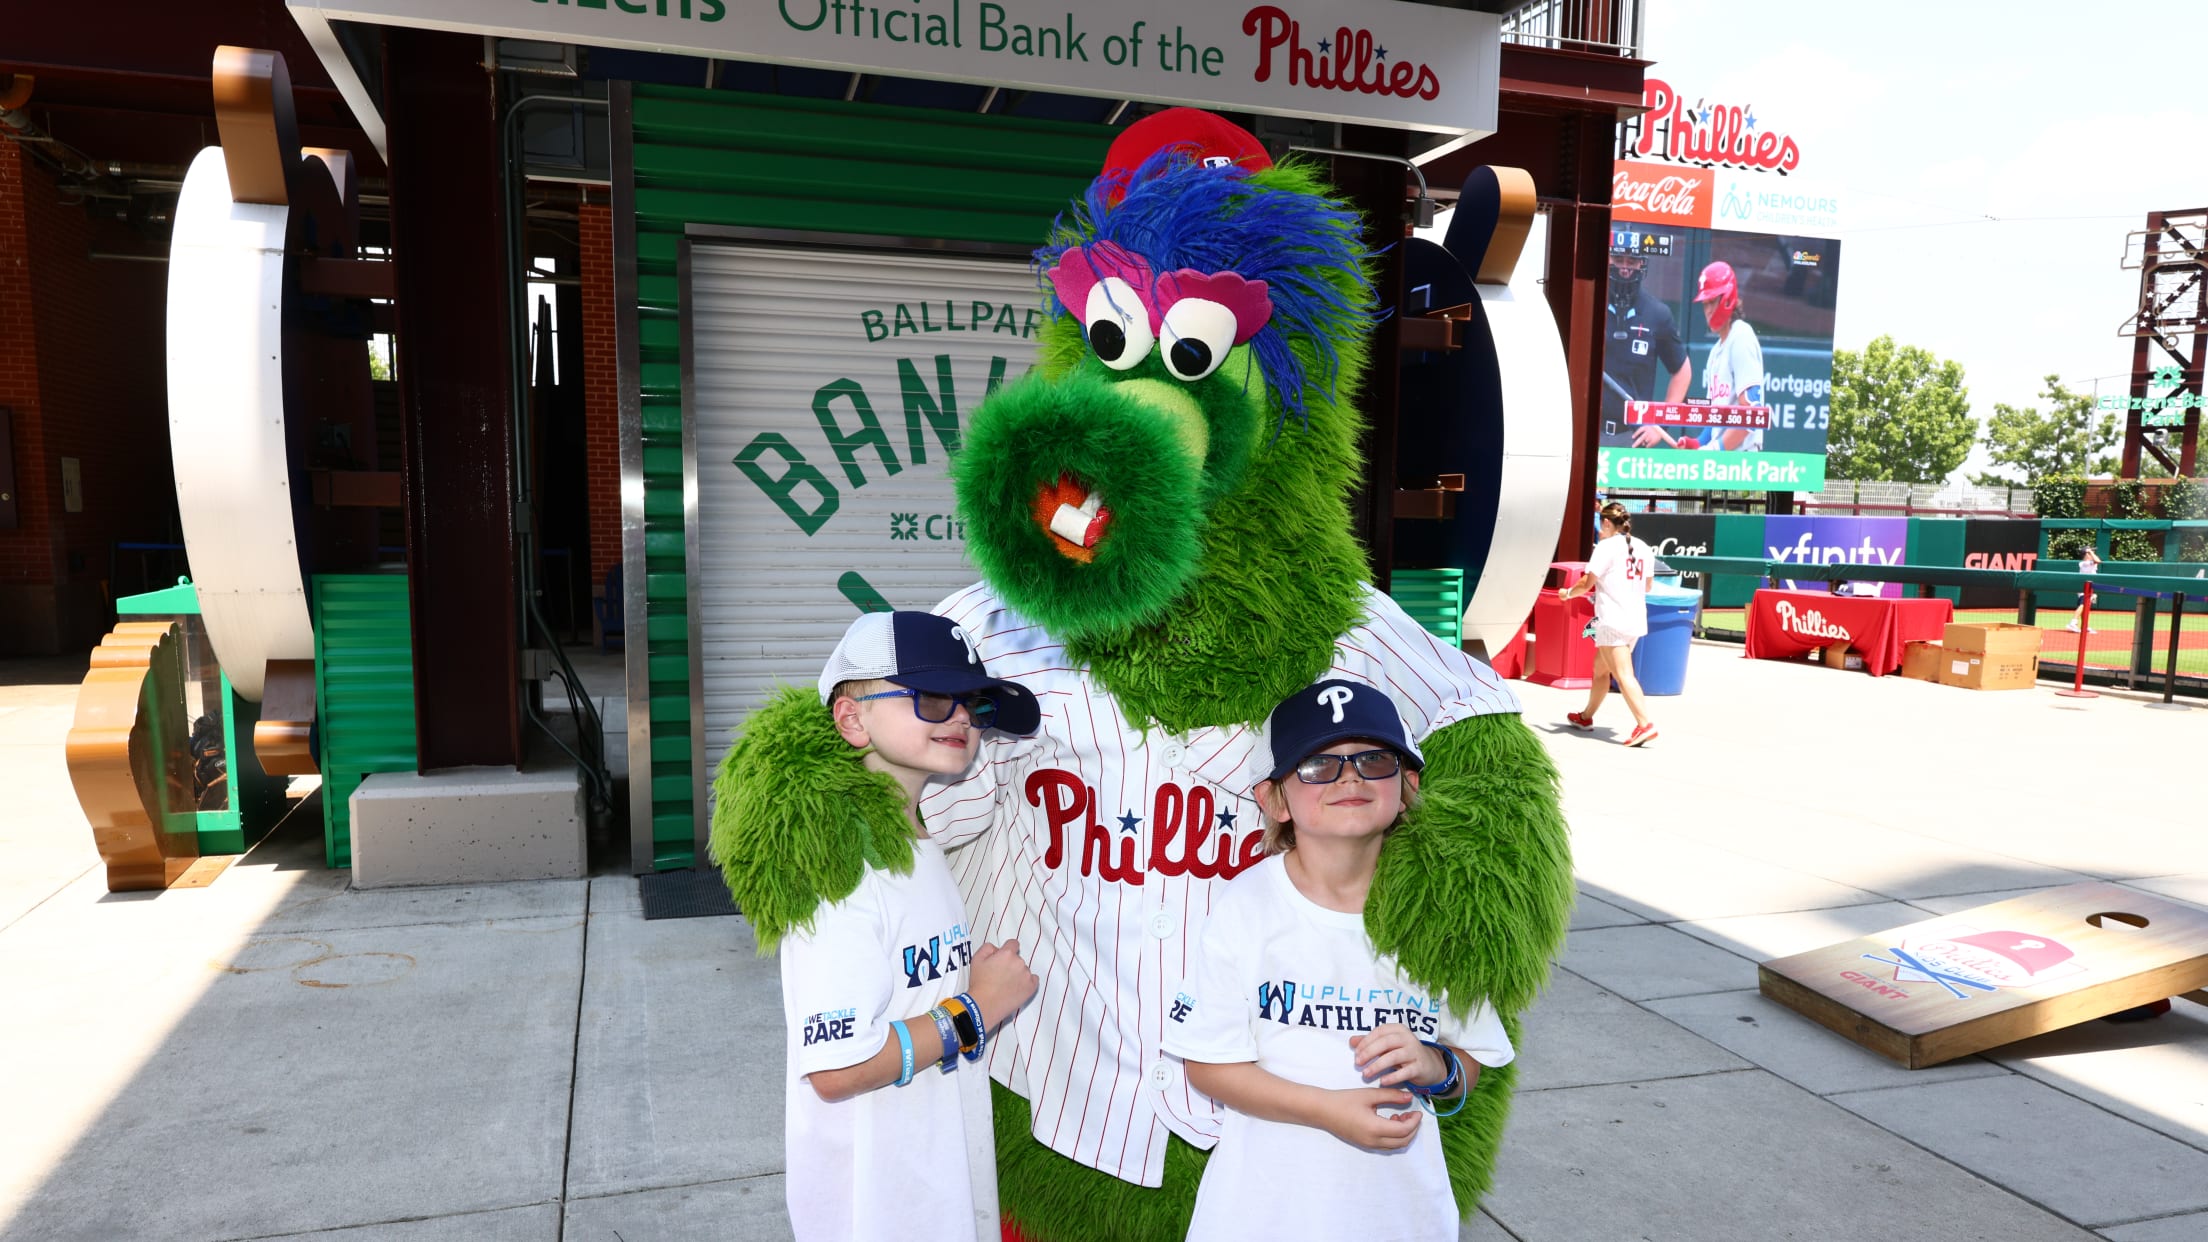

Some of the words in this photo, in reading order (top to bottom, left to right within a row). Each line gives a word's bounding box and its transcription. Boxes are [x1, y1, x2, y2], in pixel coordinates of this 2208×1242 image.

[980, 2, 1088, 62] Bank
[1102, 21, 1146, 68] of
[1157, 26, 1224, 77] the
[1242, 5, 1440, 101] Phillies
[1638, 78, 1800, 171] Phillies
[1757, 191, 1838, 214] NEMOURS
[861, 300, 1040, 342] BALLPAR
[2097, 394, 2178, 411] Citizens
[2182, 392, 2208, 409] Ba
[2141, 410, 2186, 427] Park
[732, 354, 1007, 537] BAN
[1616, 457, 1700, 481] Citizens
[1703, 459, 1753, 482] Bank
[1757, 460, 1801, 483] Park
[1768, 533, 1902, 580] xfinity
[1964, 552, 2038, 572] GIANT
[1776, 600, 1850, 641] Phillies
[1317, 685, 1354, 724] P
[1025, 769, 1267, 886] Phillie
[1300, 983, 1440, 1013] UPLIFTING
[1839, 970, 1909, 1000] GIANT
[804, 1017, 856, 1046] RARE
[1297, 1003, 1438, 1035] ATHLETES
